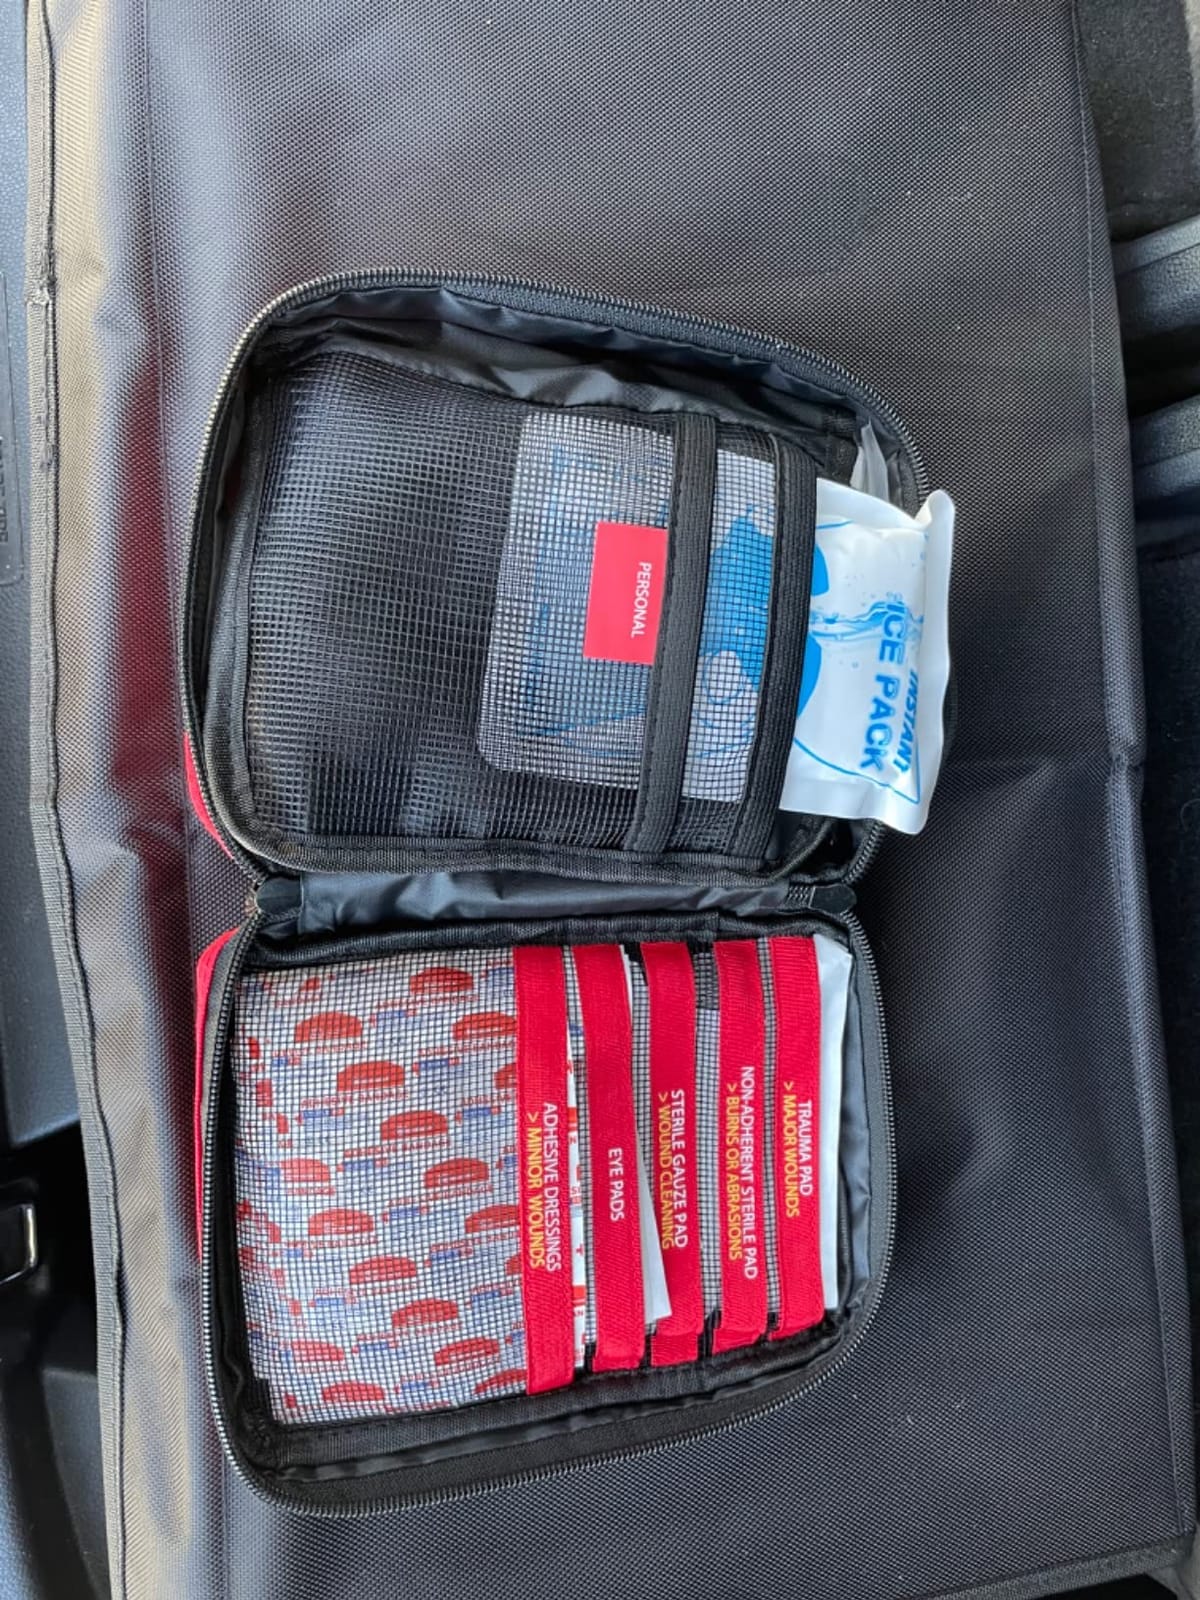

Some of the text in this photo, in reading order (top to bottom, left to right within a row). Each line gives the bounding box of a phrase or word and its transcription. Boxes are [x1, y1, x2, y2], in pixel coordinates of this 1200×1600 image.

[630, 561, 652, 638] PERSONAL
[860, 601, 906, 772] ICE PACK
[527, 1126, 545, 1269] MINIOR WOUNDS
[543, 1102, 561, 1272] ADHESIVE DRESSINGS
[608, 1147, 625, 1222] EYE PADS
[658, 1105, 674, 1250] WOUND CLEANING
[671, 1088, 688, 1248] STERILE GAUZE PAD
[726, 1096, 743, 1260] BURNS OR ABRASIONS
[740, 1066, 758, 1279] NON-ADHERENT STERILE PAD
[783, 1094, 800, 1218] MAJOR WOUNDS
[798, 1099, 814, 1197] TRAUMA PAD
